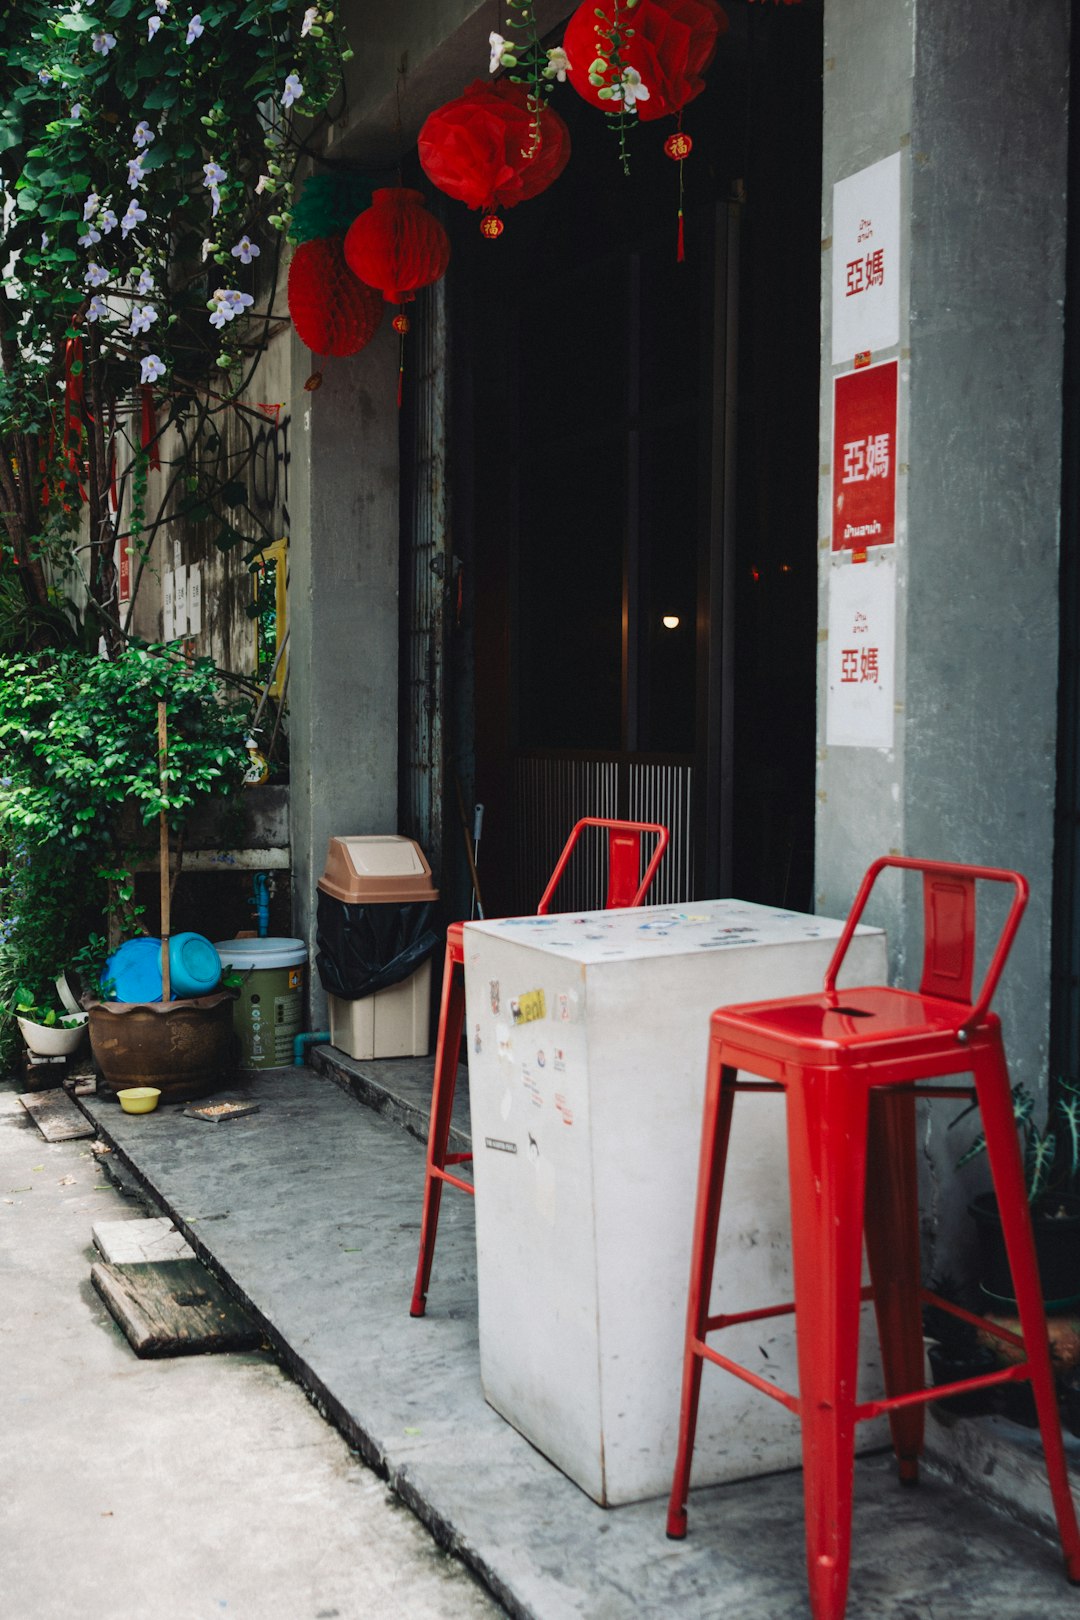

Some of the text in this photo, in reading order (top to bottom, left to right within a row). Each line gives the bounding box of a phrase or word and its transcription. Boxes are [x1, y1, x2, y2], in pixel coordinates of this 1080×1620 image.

[668, 136, 688, 157] 福
[483, 219, 499, 236] 福
[845, 248, 885, 297] 亞媽
[842, 432, 890, 485] 亞媽
[840, 646, 879, 684] 亞媽
[524, 991, 544, 1022] eni
